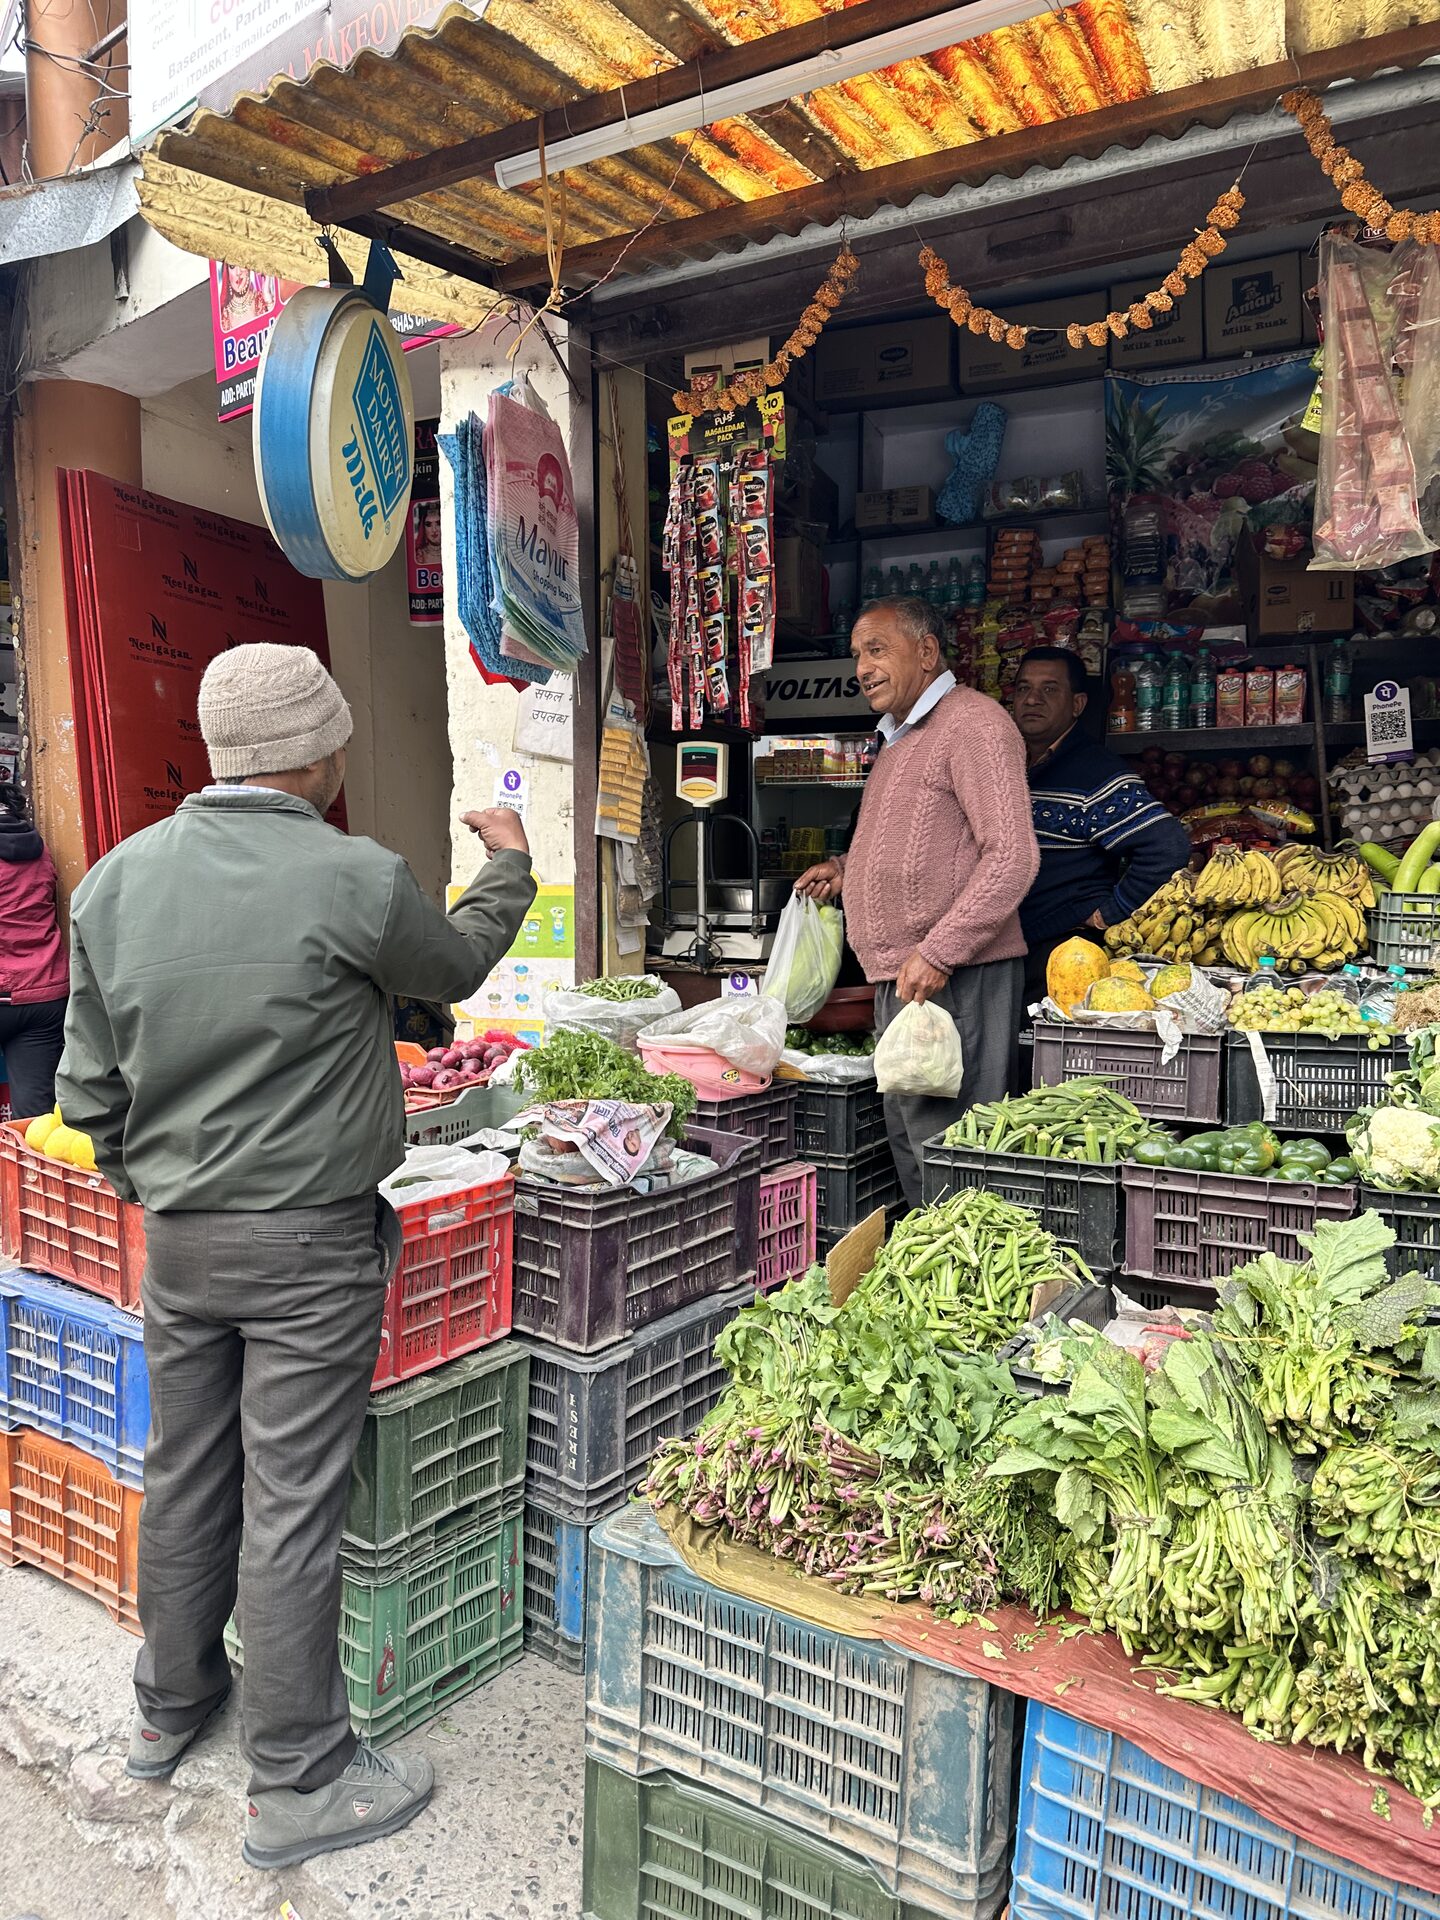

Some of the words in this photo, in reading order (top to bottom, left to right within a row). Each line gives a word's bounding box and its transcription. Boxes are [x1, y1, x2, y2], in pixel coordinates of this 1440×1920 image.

[168, 27, 231, 79] Basement,
[1222, 324, 1251, 337] Milk
[1255, 317, 1288, 330] Rusk
[223, 326, 270, 371] Beau
[1122, 341, 1151, 352] Milk
[1155, 335, 1186, 347] Rusk
[221, 386, 236, 407] ADD:
[368, 350, 405, 489] MOTHER
[671, 420, 686, 432] NEW
[704, 421, 745, 438] MASALEDAAR
[367, 392, 394, 485] DAIRY
[717, 432, 734, 443] PACK
[341, 424, 378, 540] Milk
[515, 515, 570, 582] Mayur
[766, 676, 860, 701] VOLTAS
[1372, 701, 1402, 711] PhonePe
